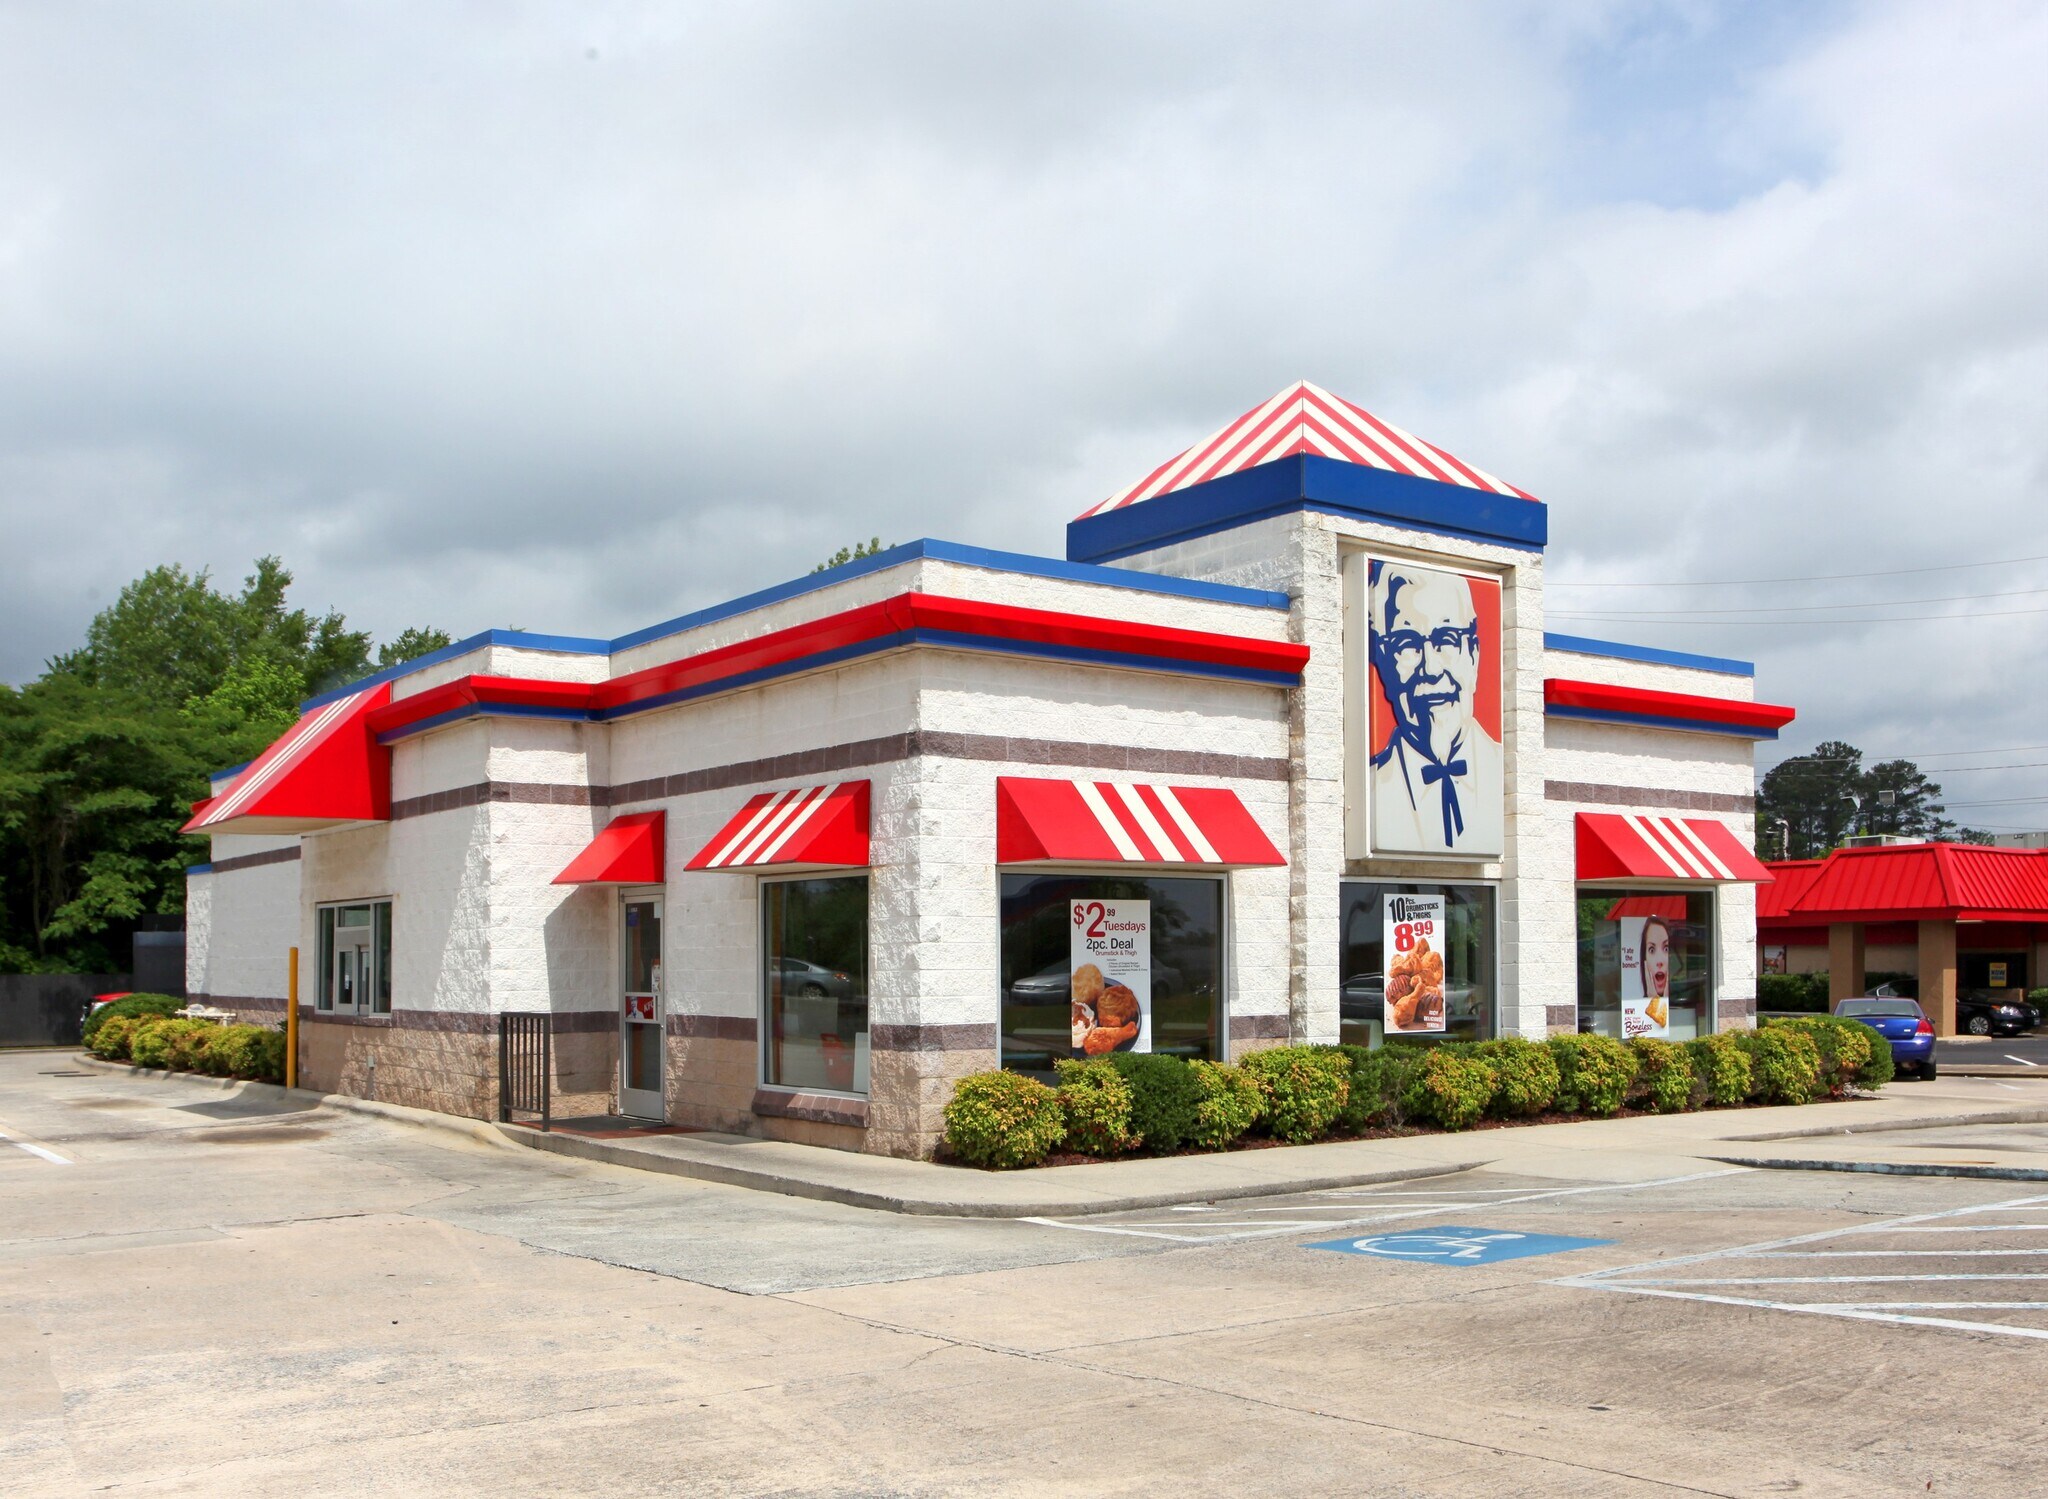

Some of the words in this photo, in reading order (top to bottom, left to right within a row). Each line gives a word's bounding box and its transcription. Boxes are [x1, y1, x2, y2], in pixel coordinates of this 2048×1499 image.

[1389, 897, 1406, 923] 10
[1406, 903, 1439, 912] DRUMSTICKS
[1407, 912, 1414, 922] &
[1413, 911, 1432, 919] THIGHS
[1103, 920, 1146, 934] Tuesdays
[1086, 938, 1108, 952] 2pc.
[1111, 938, 1134, 950] Deal
[1624, 1020, 1653, 1034] Boneless
